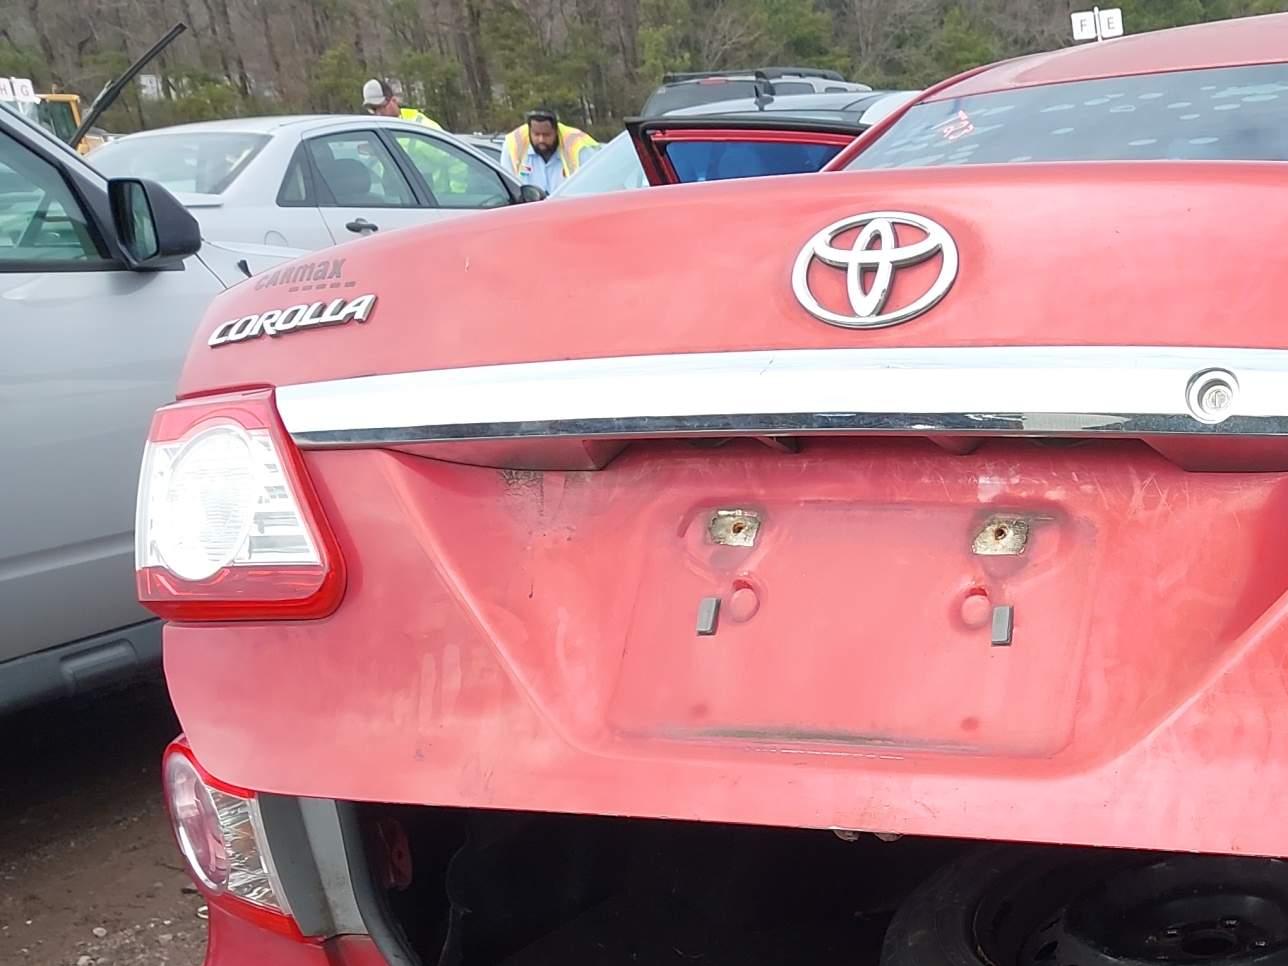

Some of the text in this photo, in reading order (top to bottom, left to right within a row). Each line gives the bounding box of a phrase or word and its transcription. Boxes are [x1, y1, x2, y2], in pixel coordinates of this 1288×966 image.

[1080, 18, 1088, 33] F
[1107, 16, 1116, 31] E
[20, 84, 30, 97] G
[207, 293, 378, 348] COROLLA
